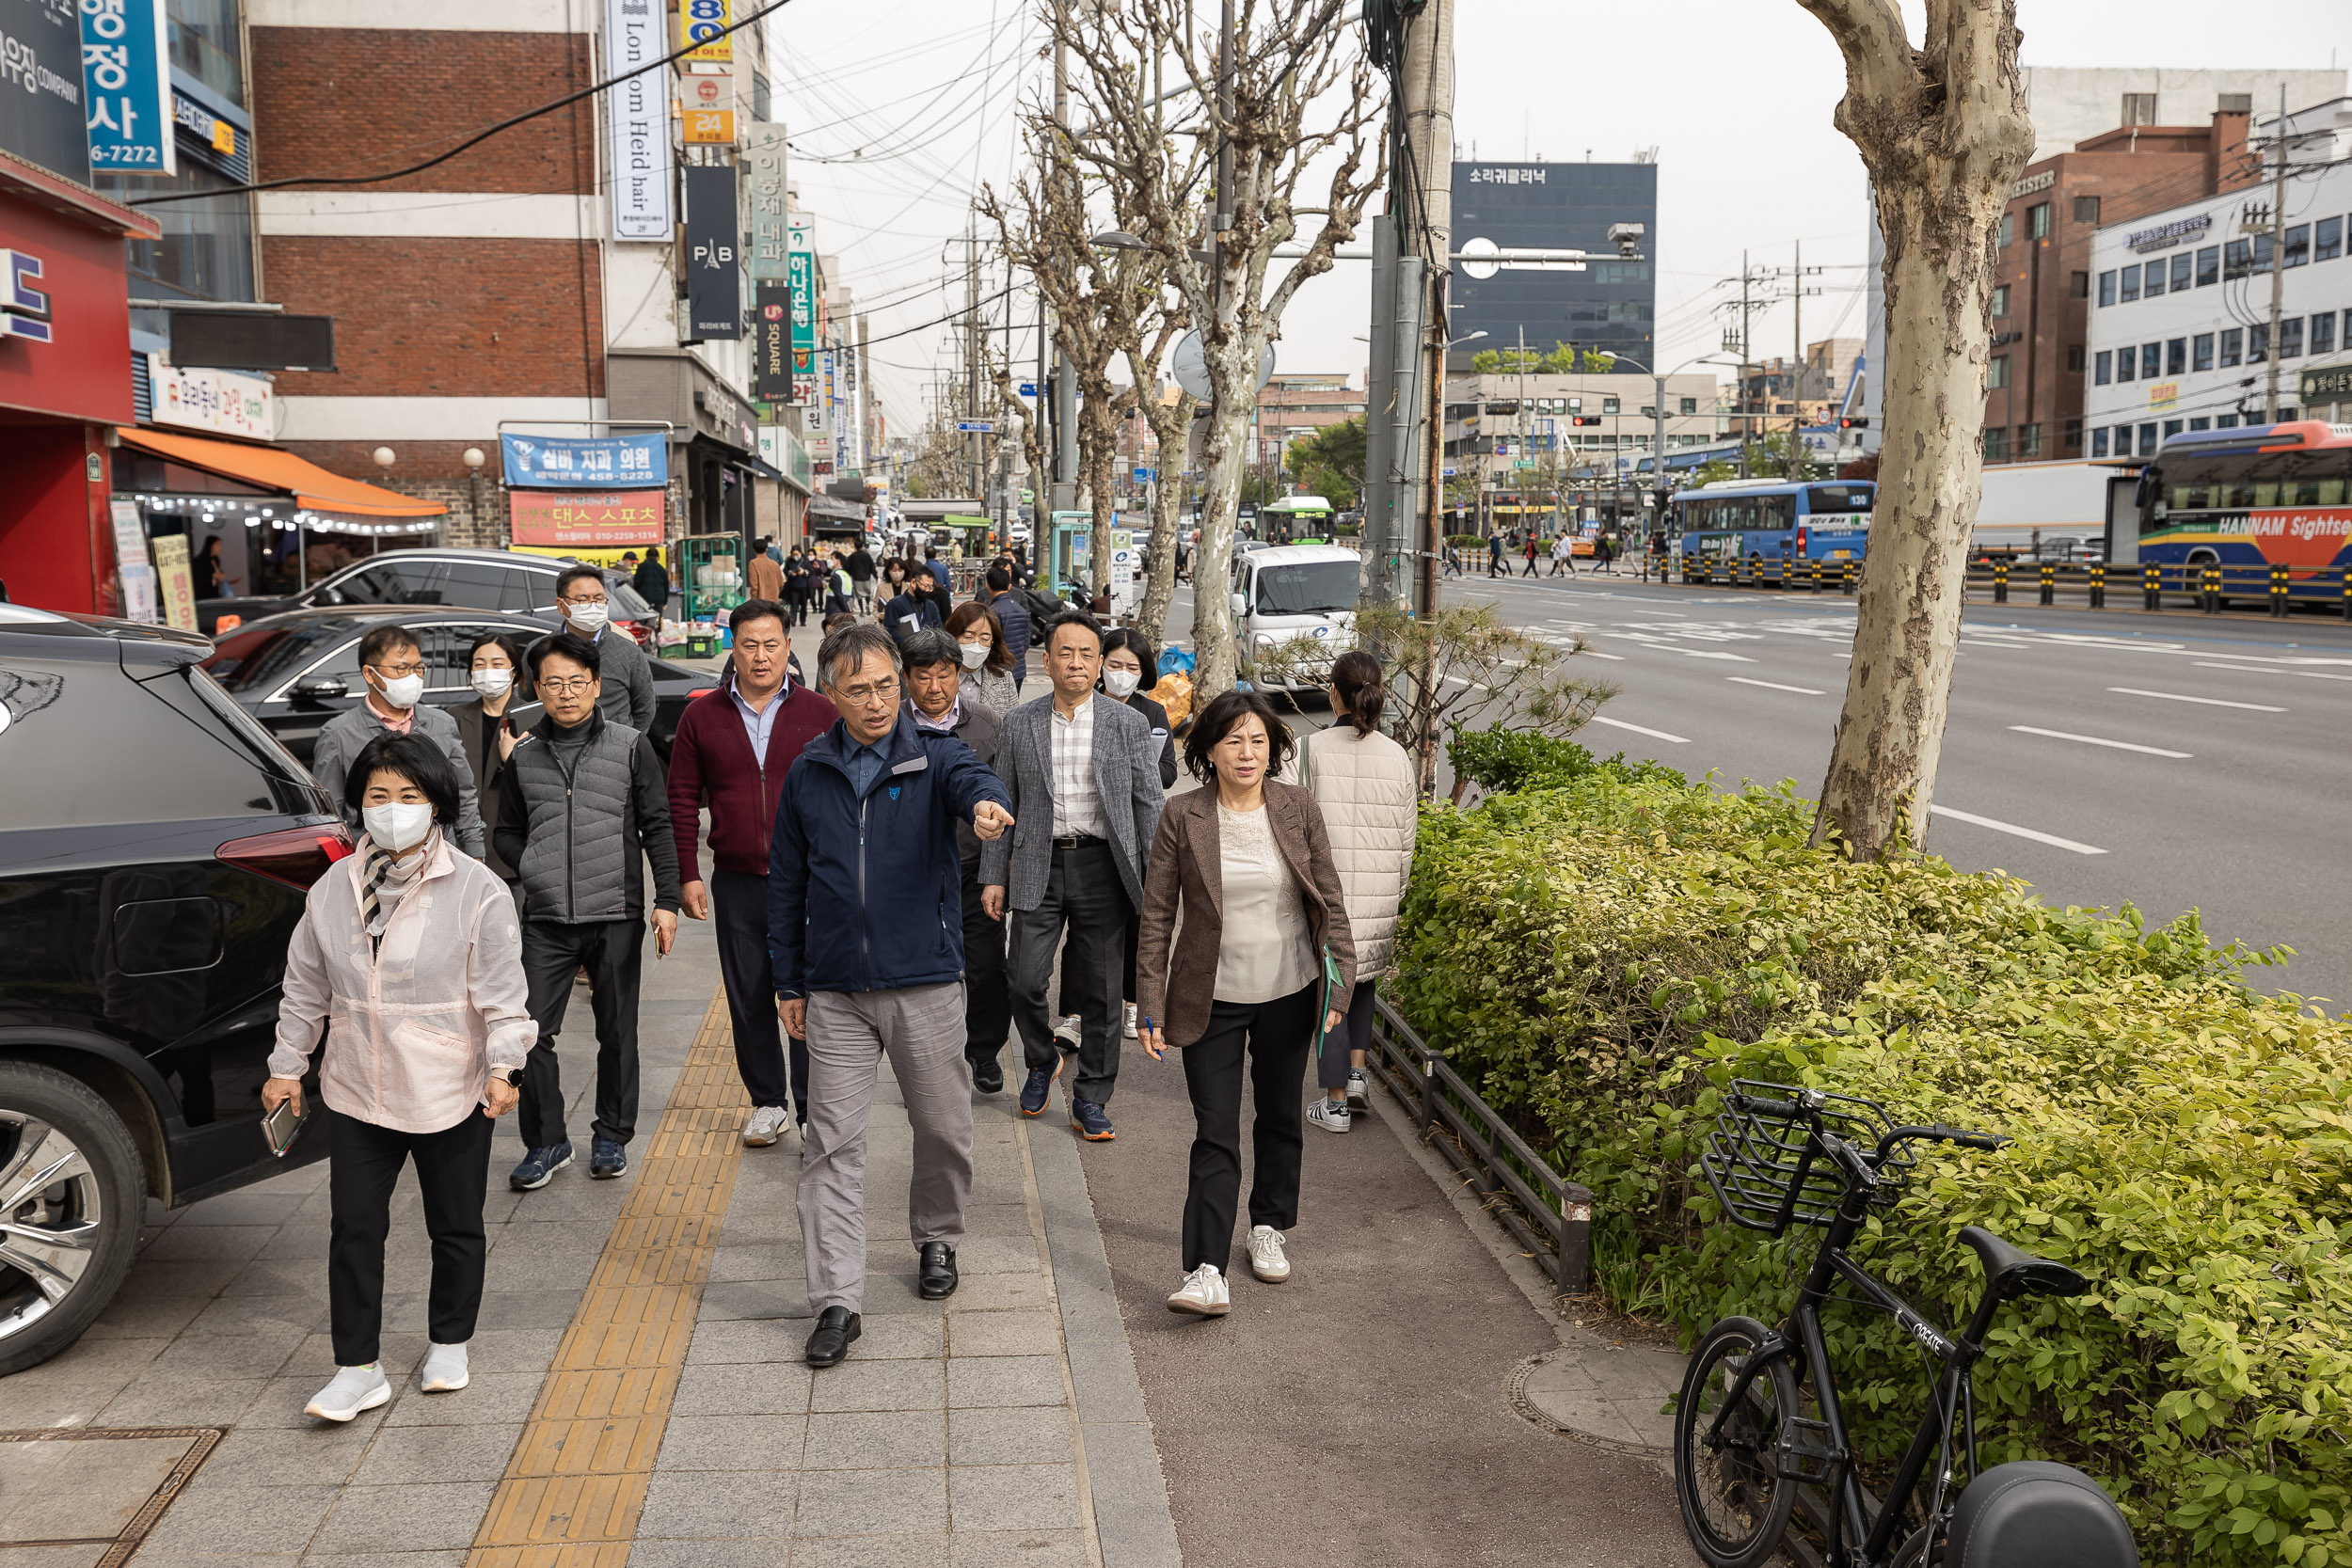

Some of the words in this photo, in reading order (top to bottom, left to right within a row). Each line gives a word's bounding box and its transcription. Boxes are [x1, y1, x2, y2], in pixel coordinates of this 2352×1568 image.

[37, 64, 78, 105] COMPANY
[696, 114, 722, 133] 24
[630, 121, 650, 169] Heid
[1470, 168, 1546, 185] 소리귀클리닉
[632, 177, 647, 211] hair
[791, 255, 809, 328] 하나은행
[767, 323, 781, 375] SQUARE
[541, 449, 574, 470] 실버
[620, 447, 651, 469] 의원
[1851, 495, 1867, 505] 130
[553, 507, 594, 530] 댄스
[598, 506, 659, 527] 스포츠
[2217, 515, 2286, 536] HANNAM
